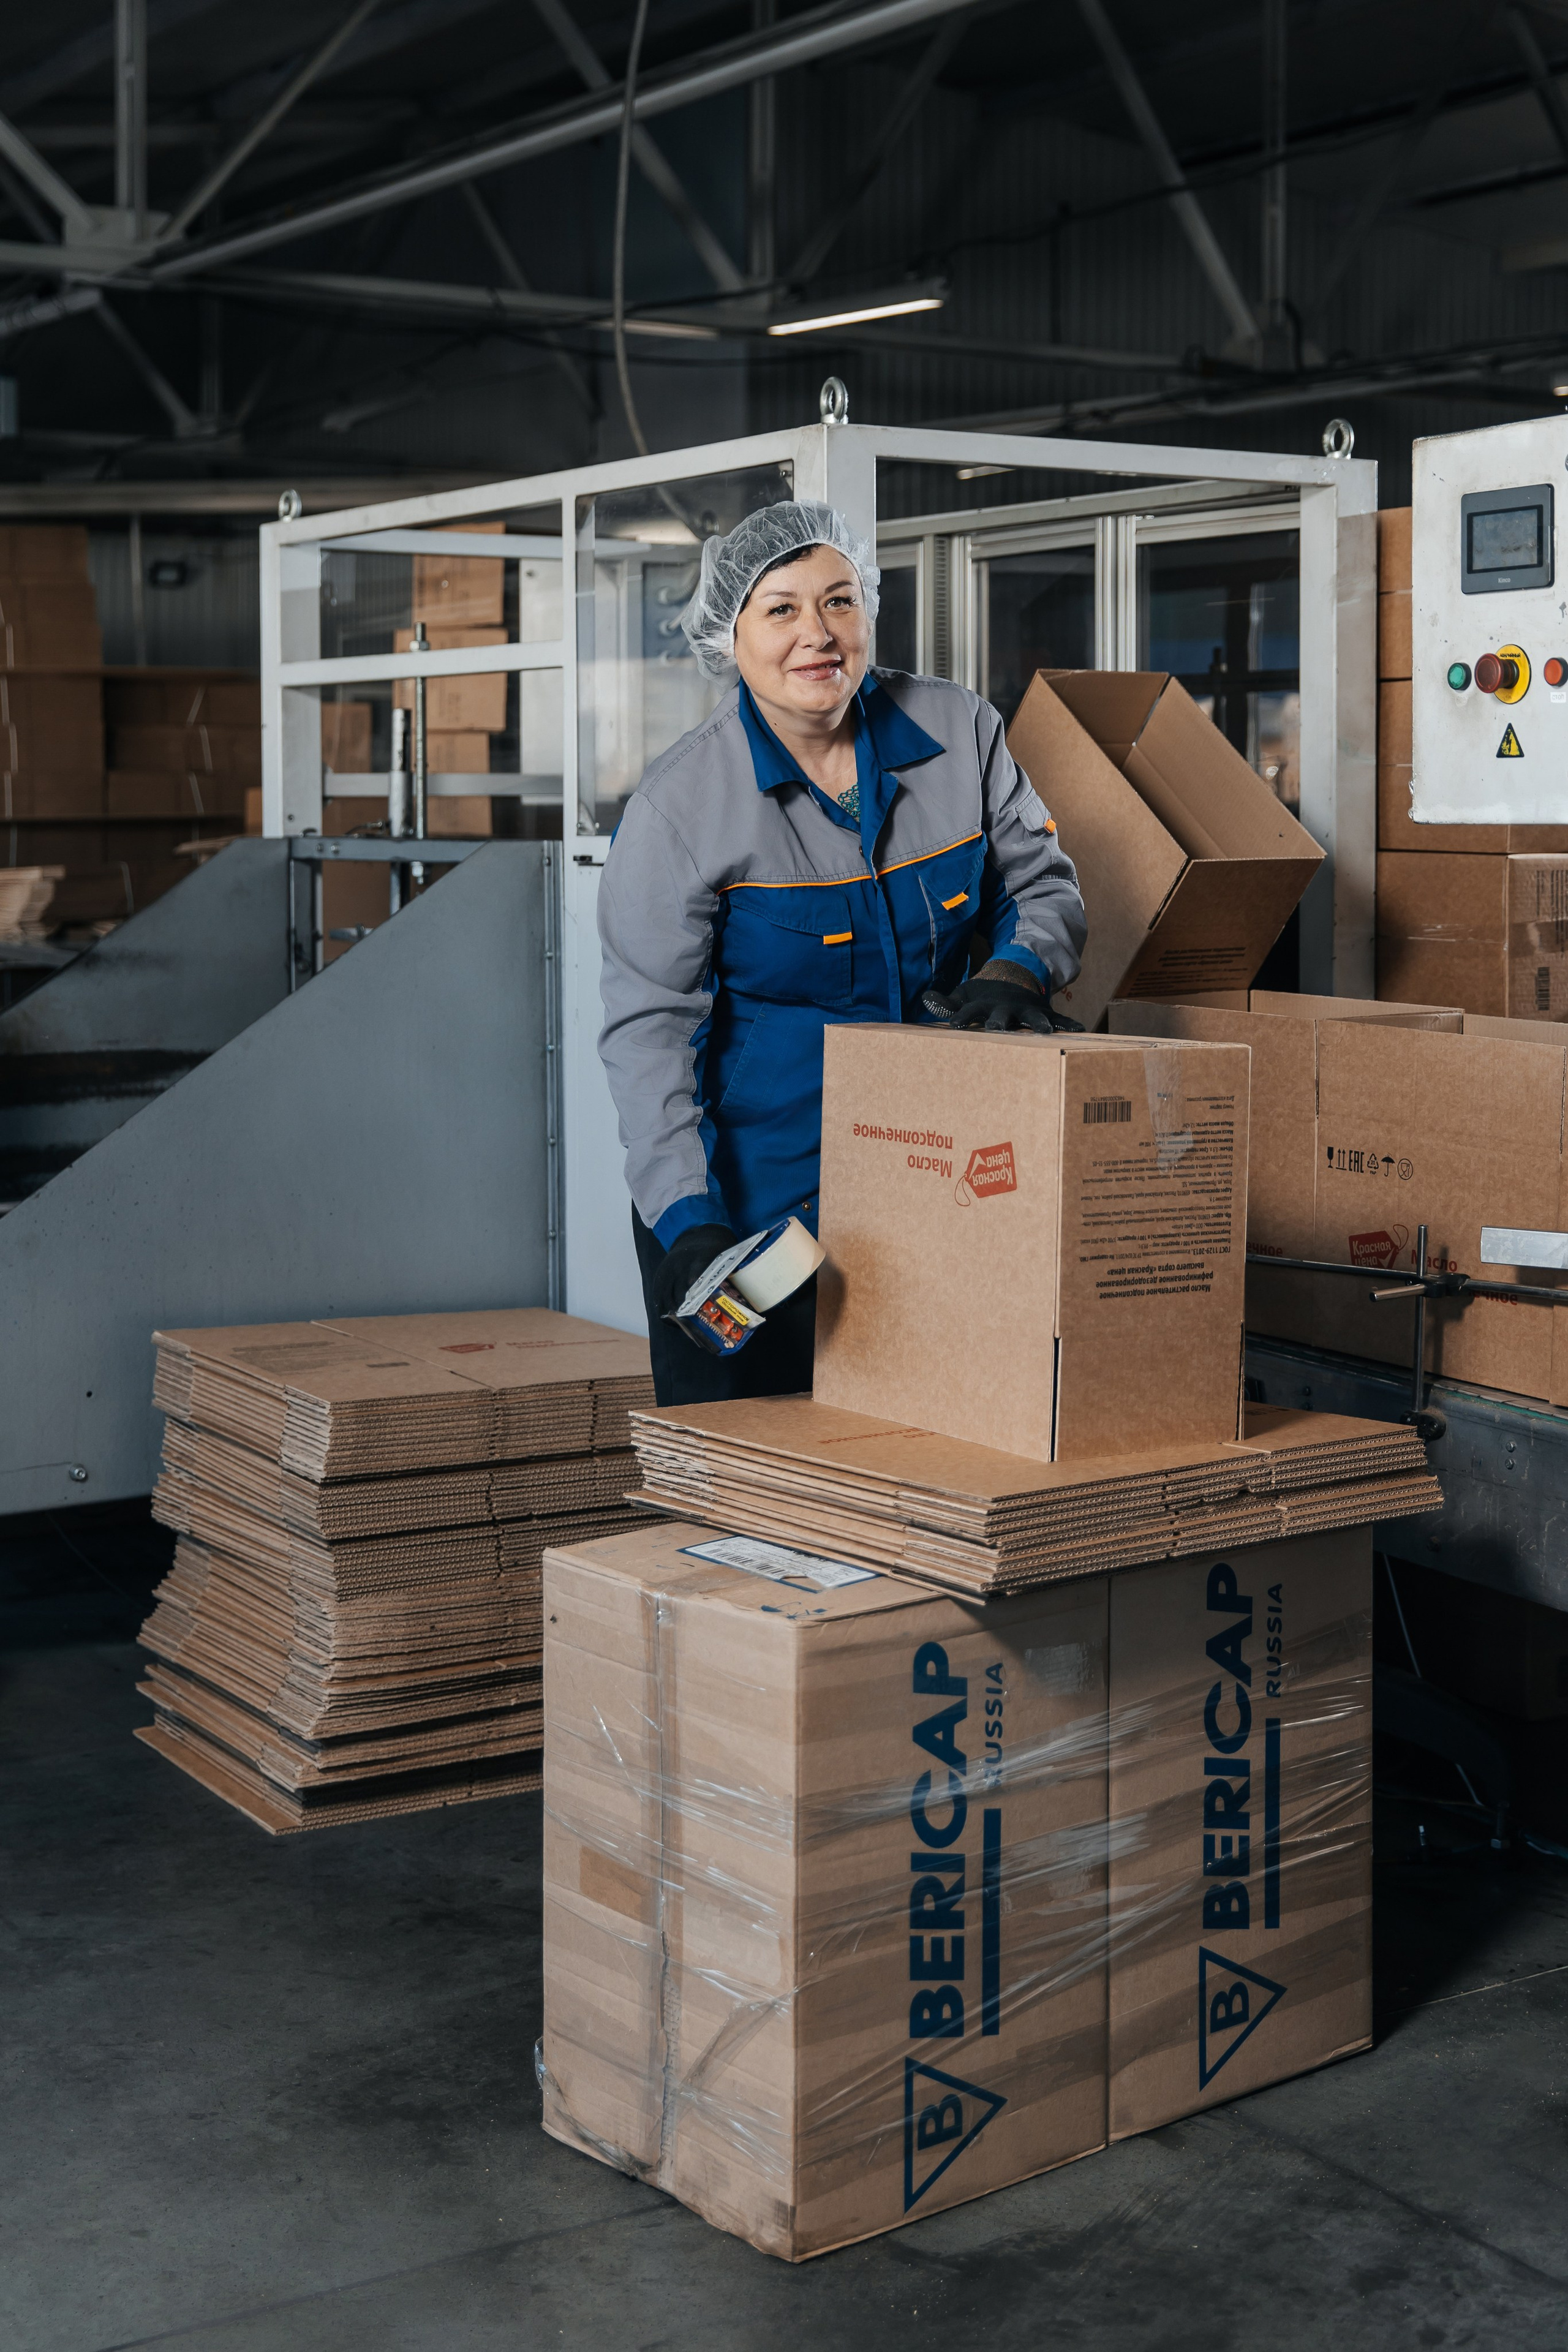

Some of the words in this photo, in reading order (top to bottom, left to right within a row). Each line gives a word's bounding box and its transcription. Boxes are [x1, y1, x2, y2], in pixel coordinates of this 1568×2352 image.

[853, 1123, 952, 1149] подсолнечное
[907, 1155, 952, 1178] Масло
[986, 1149, 1011, 1167] цена
[1349, 1150, 1365, 1173] EAC
[972, 1166, 1013, 1186] Красная
[1352, 1240, 1391, 1256] Красная
[1158, 1263, 1175, 1272] сорта
[1354, 1255, 1378, 1266] цена
[1107, 1267, 1126, 1275] цена»
[1128, 1264, 1156, 1276] «Красная
[1159, 1271, 1213, 1285] рафинированное
[1096, 1275, 1158, 1288] дезодорированное
[1147, 1285, 1189, 1295] растительное
[1191, 1285, 1211, 1294] Масло
[1099, 1288, 1145, 1298] подсолнечное
[1265, 1583, 1283, 1698] RUSSIA
[984, 1664, 1003, 1787] RUSSIA
[1203, 1564, 1253, 1929] BERICAP
[910, 1642, 967, 2038] BERICAP
[1210, 1982, 1249, 2034] B
[918, 2094, 962, 2150] B
